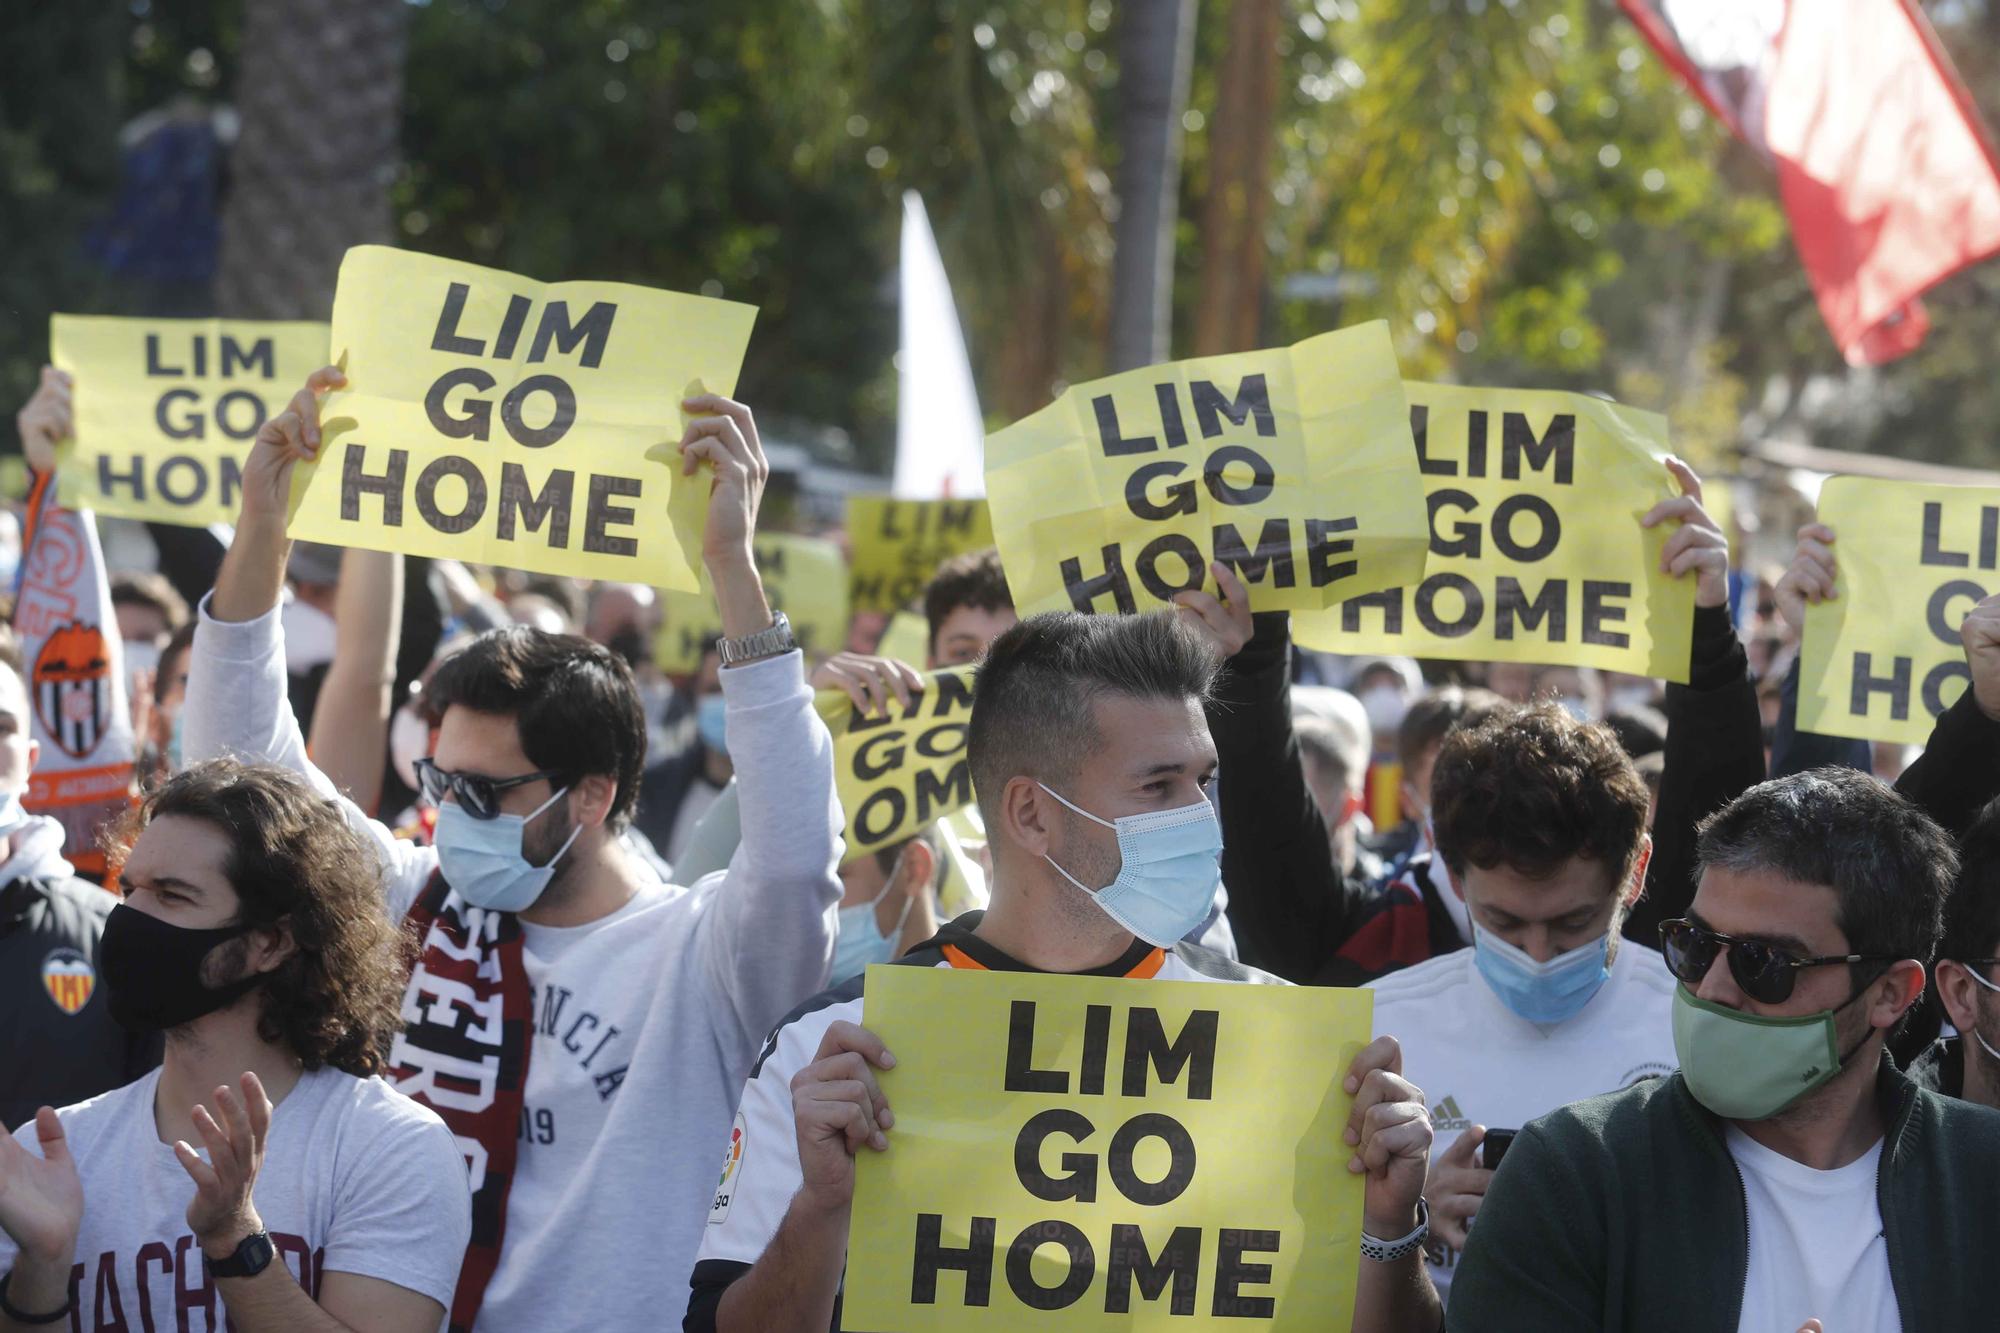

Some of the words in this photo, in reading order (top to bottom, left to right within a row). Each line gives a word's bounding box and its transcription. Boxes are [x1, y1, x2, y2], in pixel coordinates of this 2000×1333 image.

[146, 334, 275, 379] LIM
[431, 283, 618, 369] LIM
[154, 388, 266, 441] GO
[424, 368, 577, 449] GO
[1092, 373, 1277, 457] LIM
[1410, 404, 1576, 486] LIM
[97, 454, 243, 508] HO
[341, 444, 643, 558] HOME
[1125, 446, 1276, 521] GO
[1426, 488, 1561, 564] GO
[1920, 501, 2000, 570] LI
[1060, 517, 1359, 615] HOME
[1342, 571, 1632, 649] HOME
[1926, 579, 1989, 646] G
[1850, 652, 1974, 721] HO
[853, 722, 970, 782] GO
[854, 758, 972, 846] OM
[530, 983, 630, 1102] NCIA
[1004, 1000, 1220, 1101] LIM
[519, 1106, 555, 1144] 19
[1014, 1109, 1197, 1207] GO
[1430, 1119, 1472, 1131] didas
[911, 1213, 1281, 1319] HOME
